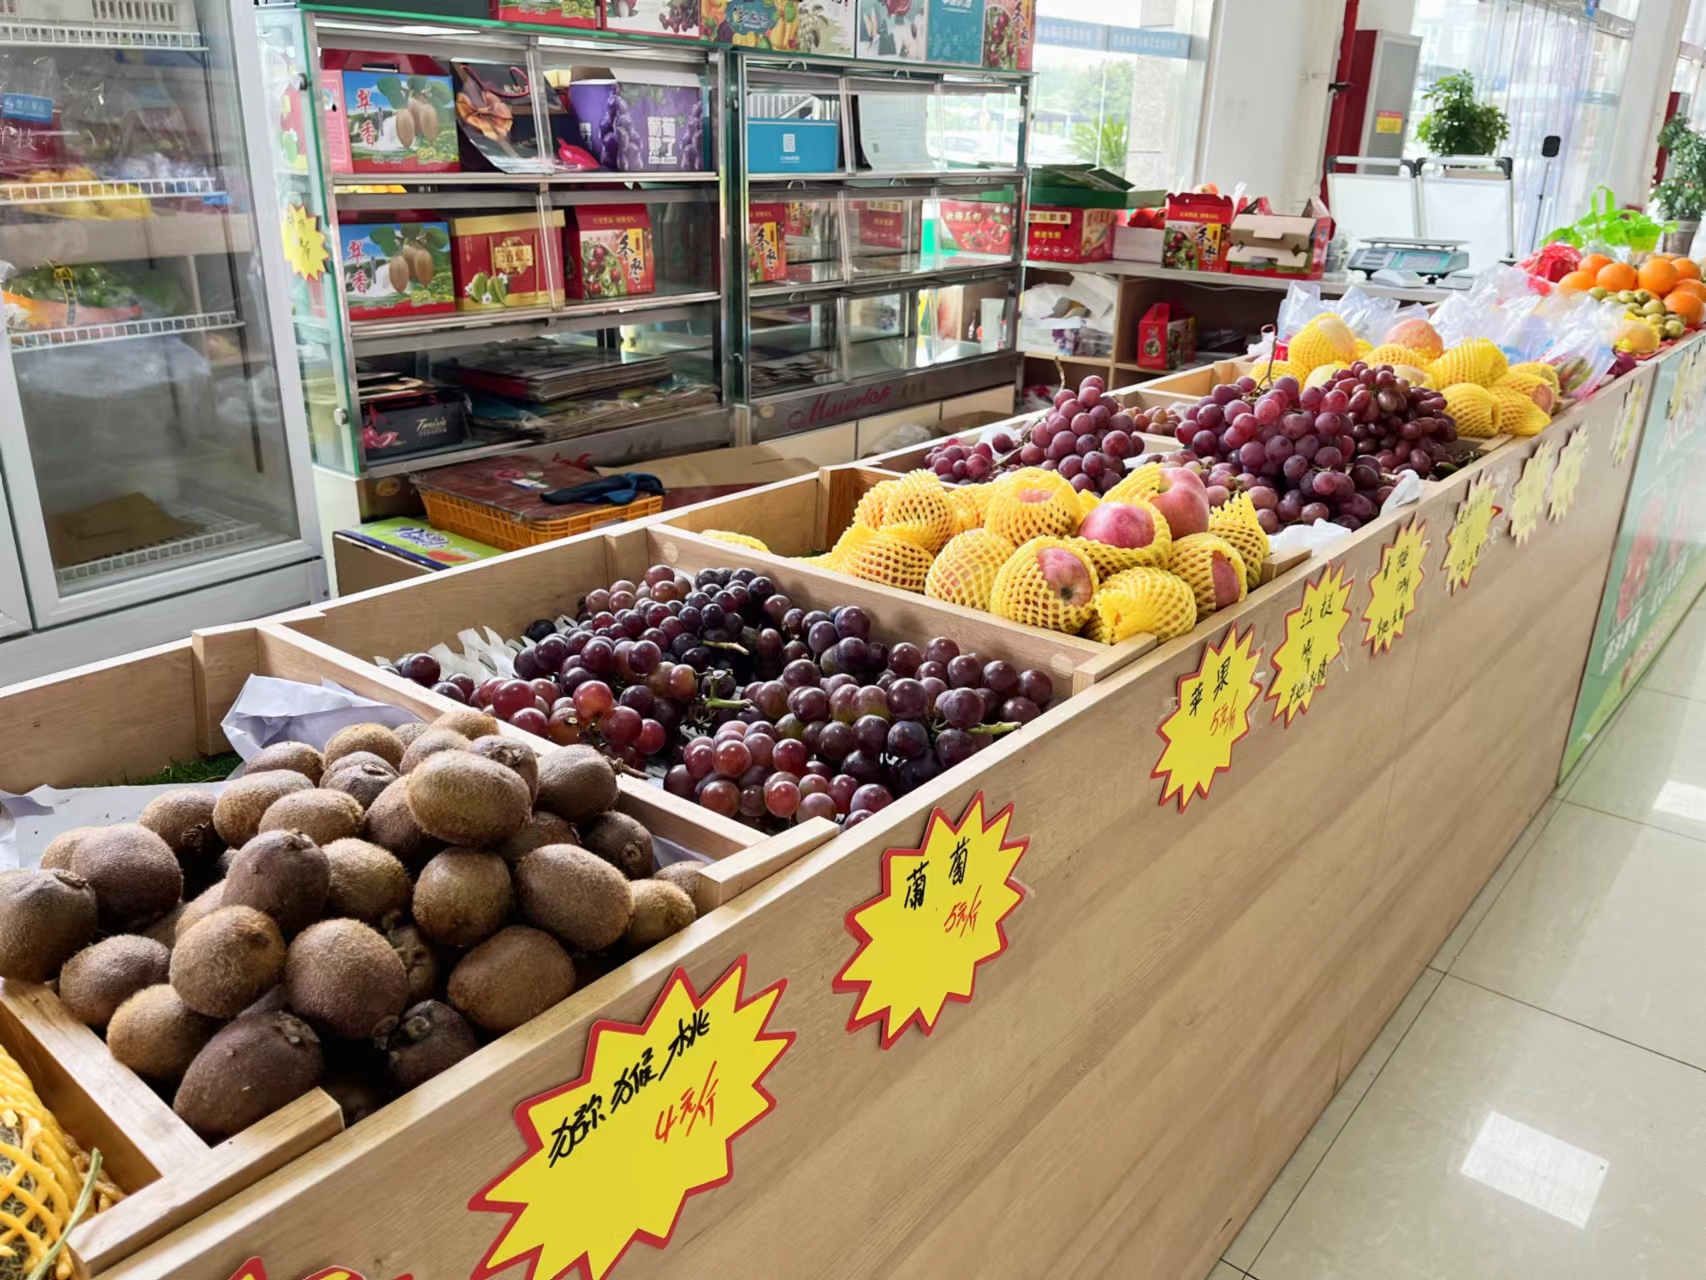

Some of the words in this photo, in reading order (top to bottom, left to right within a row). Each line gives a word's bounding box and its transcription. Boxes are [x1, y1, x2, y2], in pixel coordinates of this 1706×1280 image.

[355, 87, 377, 148] 翠香
[347, 239, 369, 295] 翠香
[617, 234, 644, 282] 冬枣
[755, 228, 777, 270] 冬枣
[1189, 655, 1231, 717] 苹果
[904, 836, 971, 911] 葡萄
[548, 1009, 711, 1168] 猕猴桃
